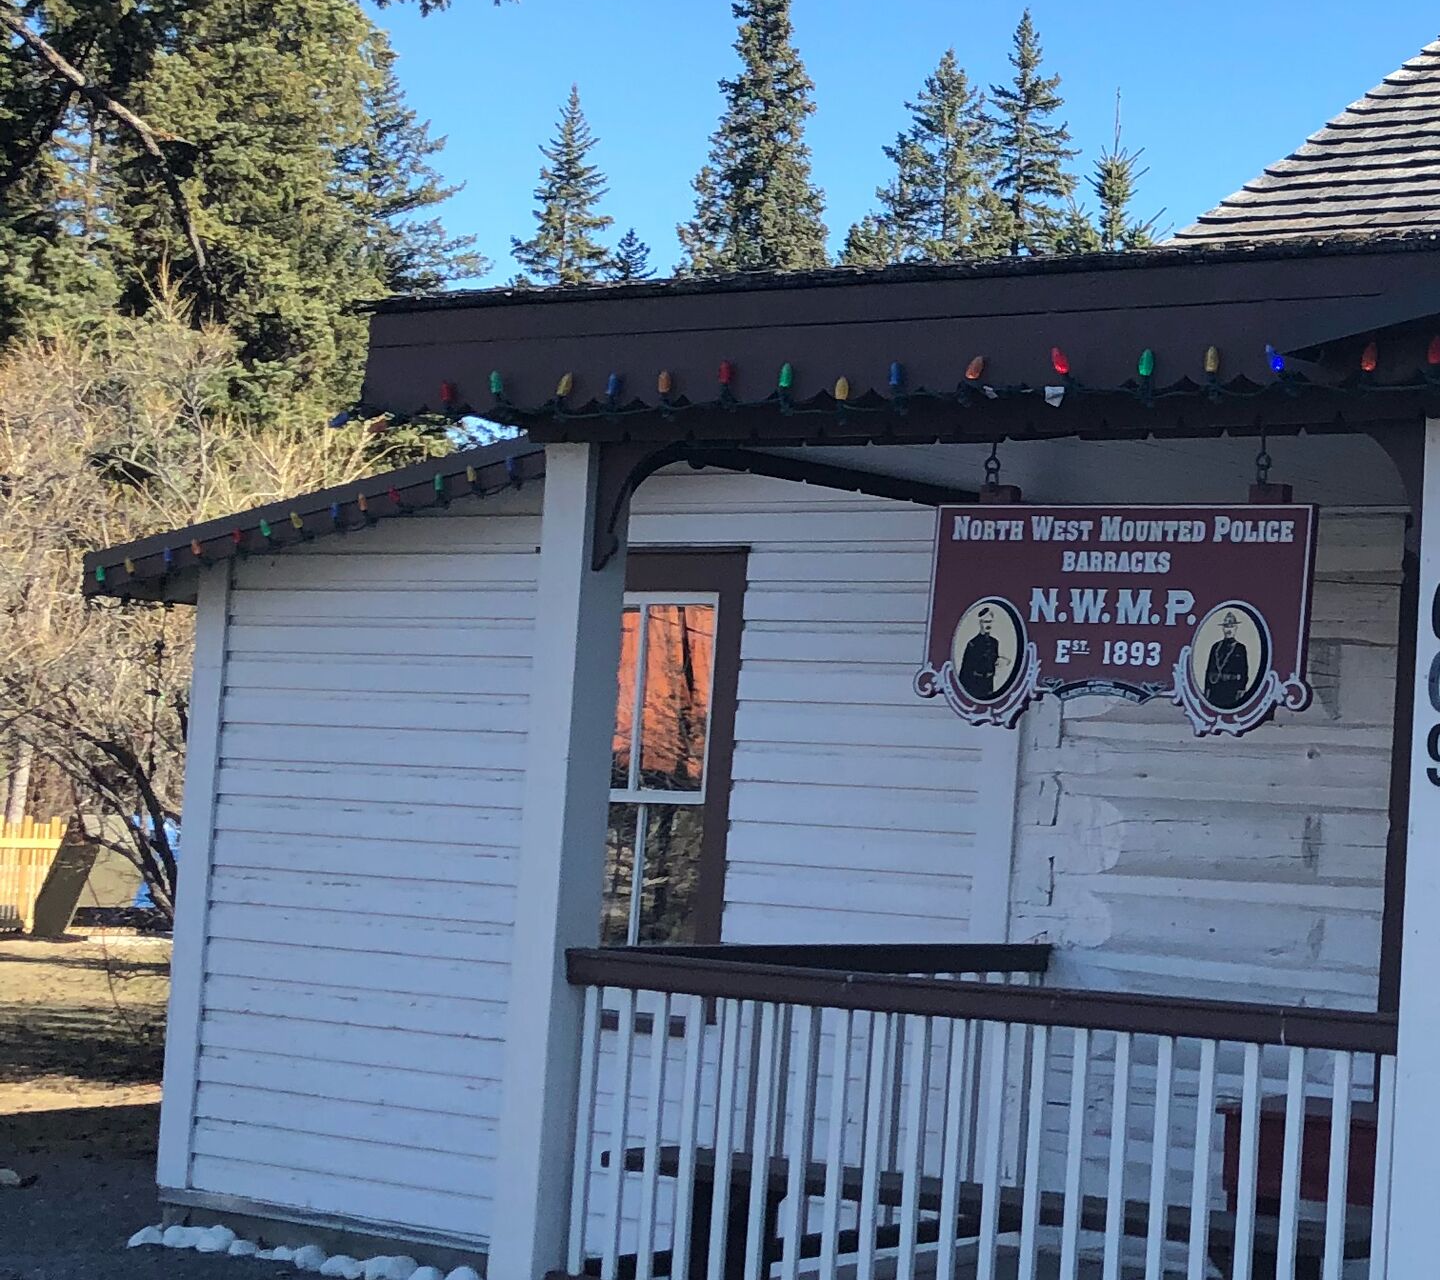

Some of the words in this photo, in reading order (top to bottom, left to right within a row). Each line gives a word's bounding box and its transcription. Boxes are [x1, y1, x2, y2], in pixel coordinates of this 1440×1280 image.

[952, 515, 1024, 541] NORTH
[1031, 516, 1093, 542] WEST
[1100, 516, 1206, 543] MOUNTED
[1213, 516, 1294, 543] POLICE
[1062, 551, 1171, 573] BARRACKS
[1029, 588, 1197, 625] N.W.M.P.
[1102, 640, 1161, 667] 1893
